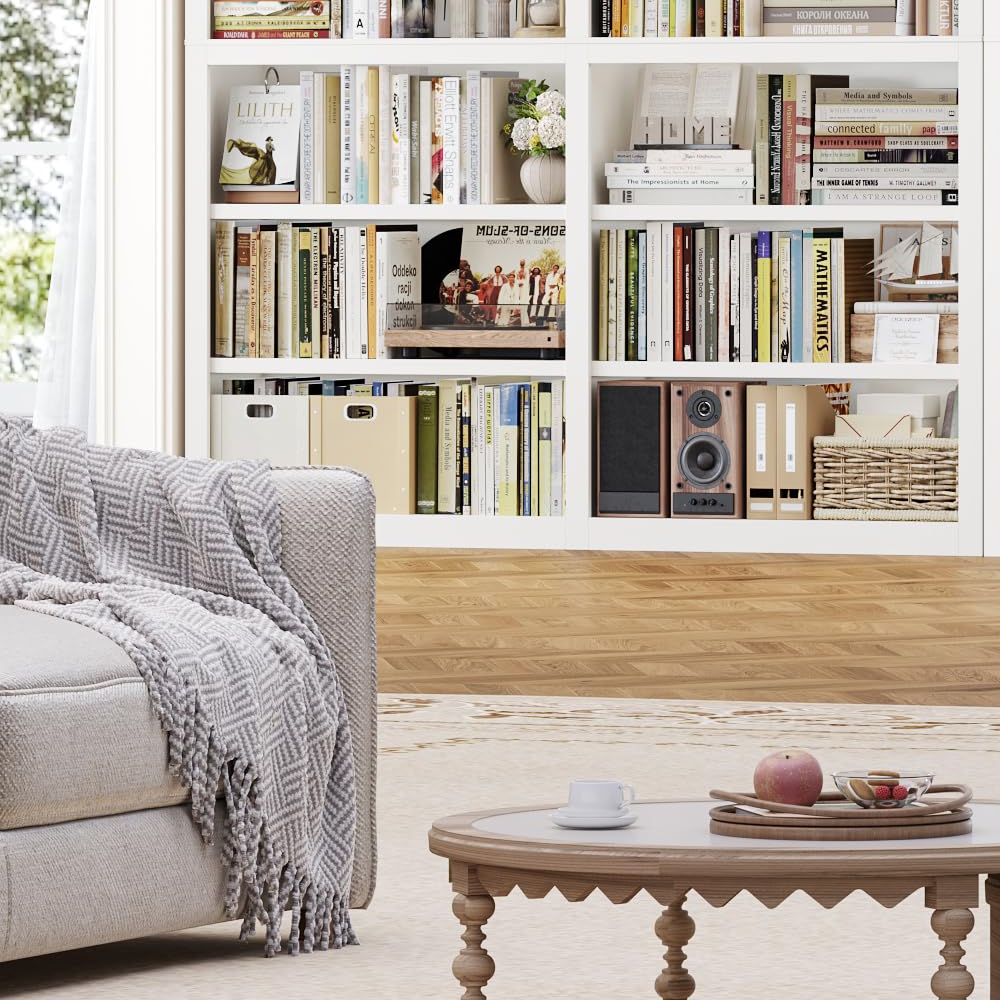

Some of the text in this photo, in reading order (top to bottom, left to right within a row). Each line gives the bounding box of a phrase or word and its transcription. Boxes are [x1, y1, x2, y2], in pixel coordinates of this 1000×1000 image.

[797, 10, 869, 19] КОРОЛИ ОКЕАНА
[883, 92, 912, 100] Symbols
[237, 103, 292, 117] LILITH
[443, 80, 456, 189] Elliott Erwitt Snaps
[828, 123, 912, 134] connected family
[392, 265, 416, 277] Oddeko
[398, 282, 412, 295] racji
[816, 250, 828, 351] MATHEMATICS
[442, 407, 452, 470] Media and Symbols
